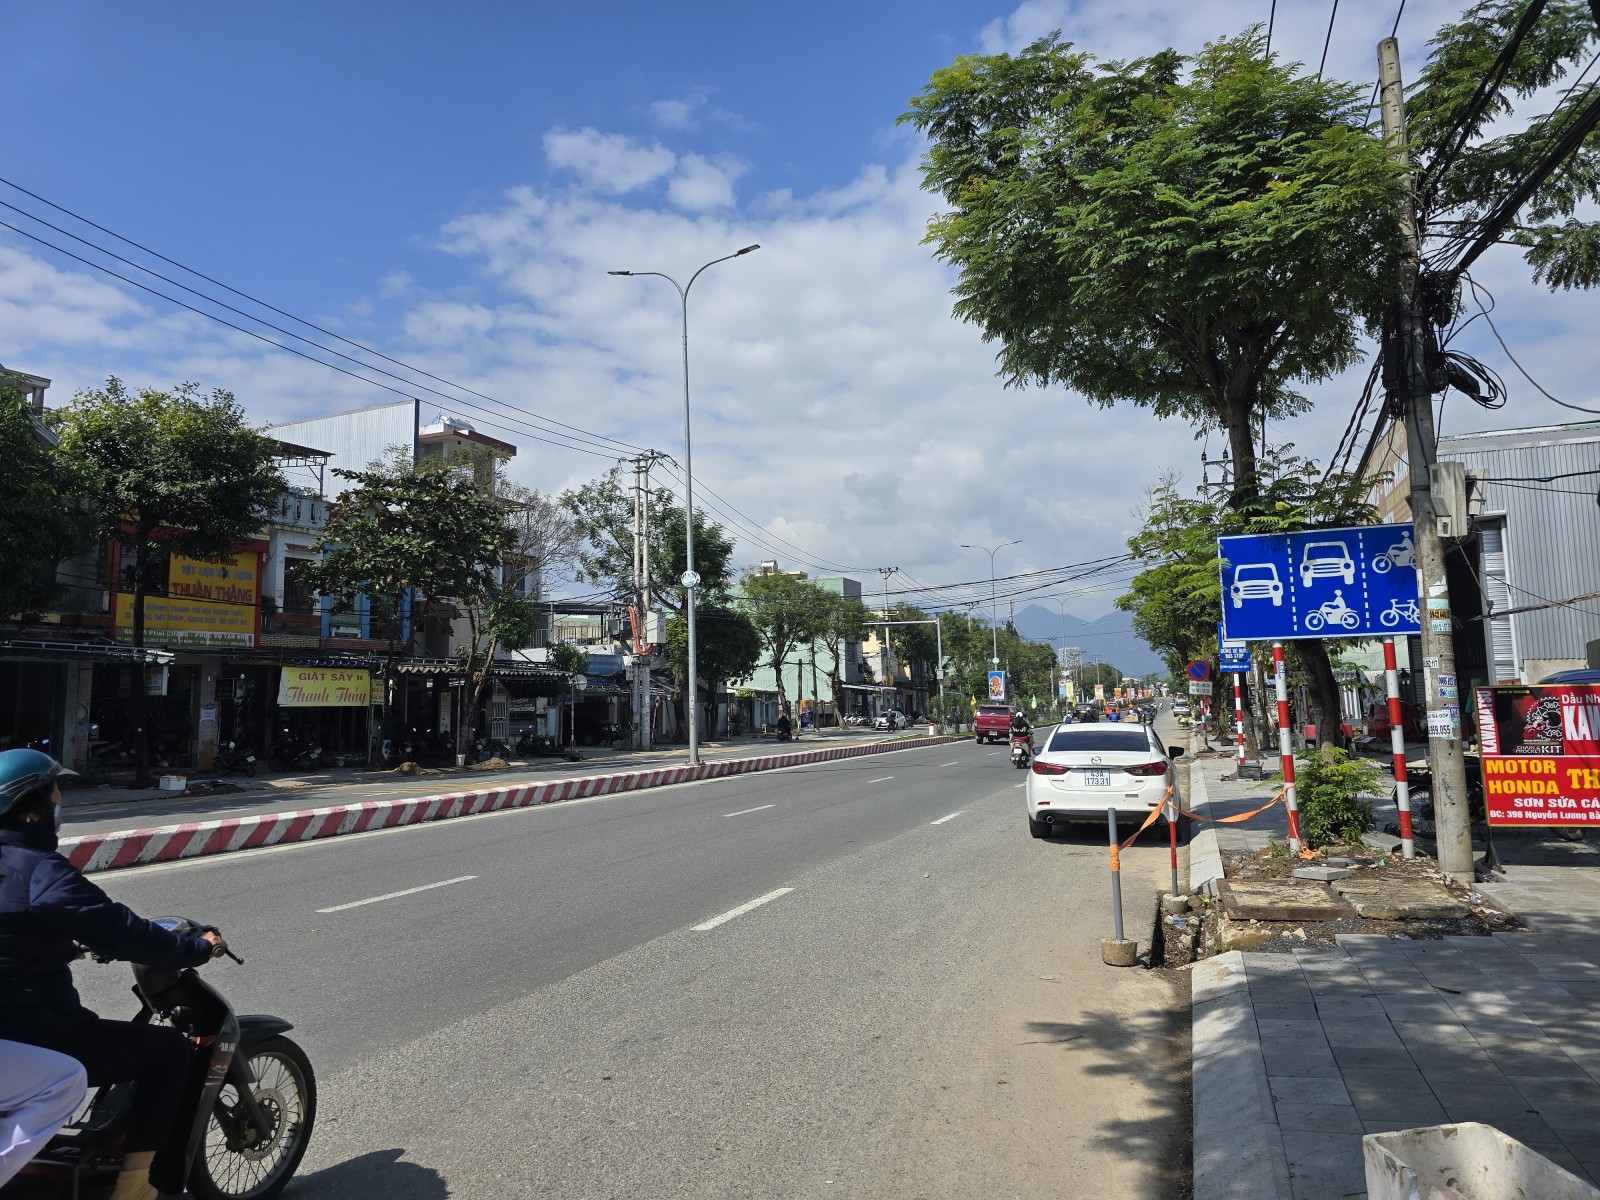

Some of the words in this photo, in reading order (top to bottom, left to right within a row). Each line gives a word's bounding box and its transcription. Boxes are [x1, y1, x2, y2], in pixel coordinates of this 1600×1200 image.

[330, 670, 354, 681] SẤY
[287, 686, 330, 703] Thanh
[1562, 692, 1583, 704] Dầu
[1477, 690, 1498, 753] KAWAMATSU
[1541, 745, 1562, 754] KIT
[1486, 759, 1557, 775] MOTOR
[1090, 769, 1105, 778] 43A
[1488, 779, 1560, 795] HONDA
[1514, 797, 1544, 807] SƠN
[1548, 795, 1578, 808] SỬA
[1490, 810, 1505, 818] ĐC:
[1507, 810, 1523, 818] 398
[1524, 809, 1558, 820] Nguyễn
[1560, 812, 1587, 821] Lương
